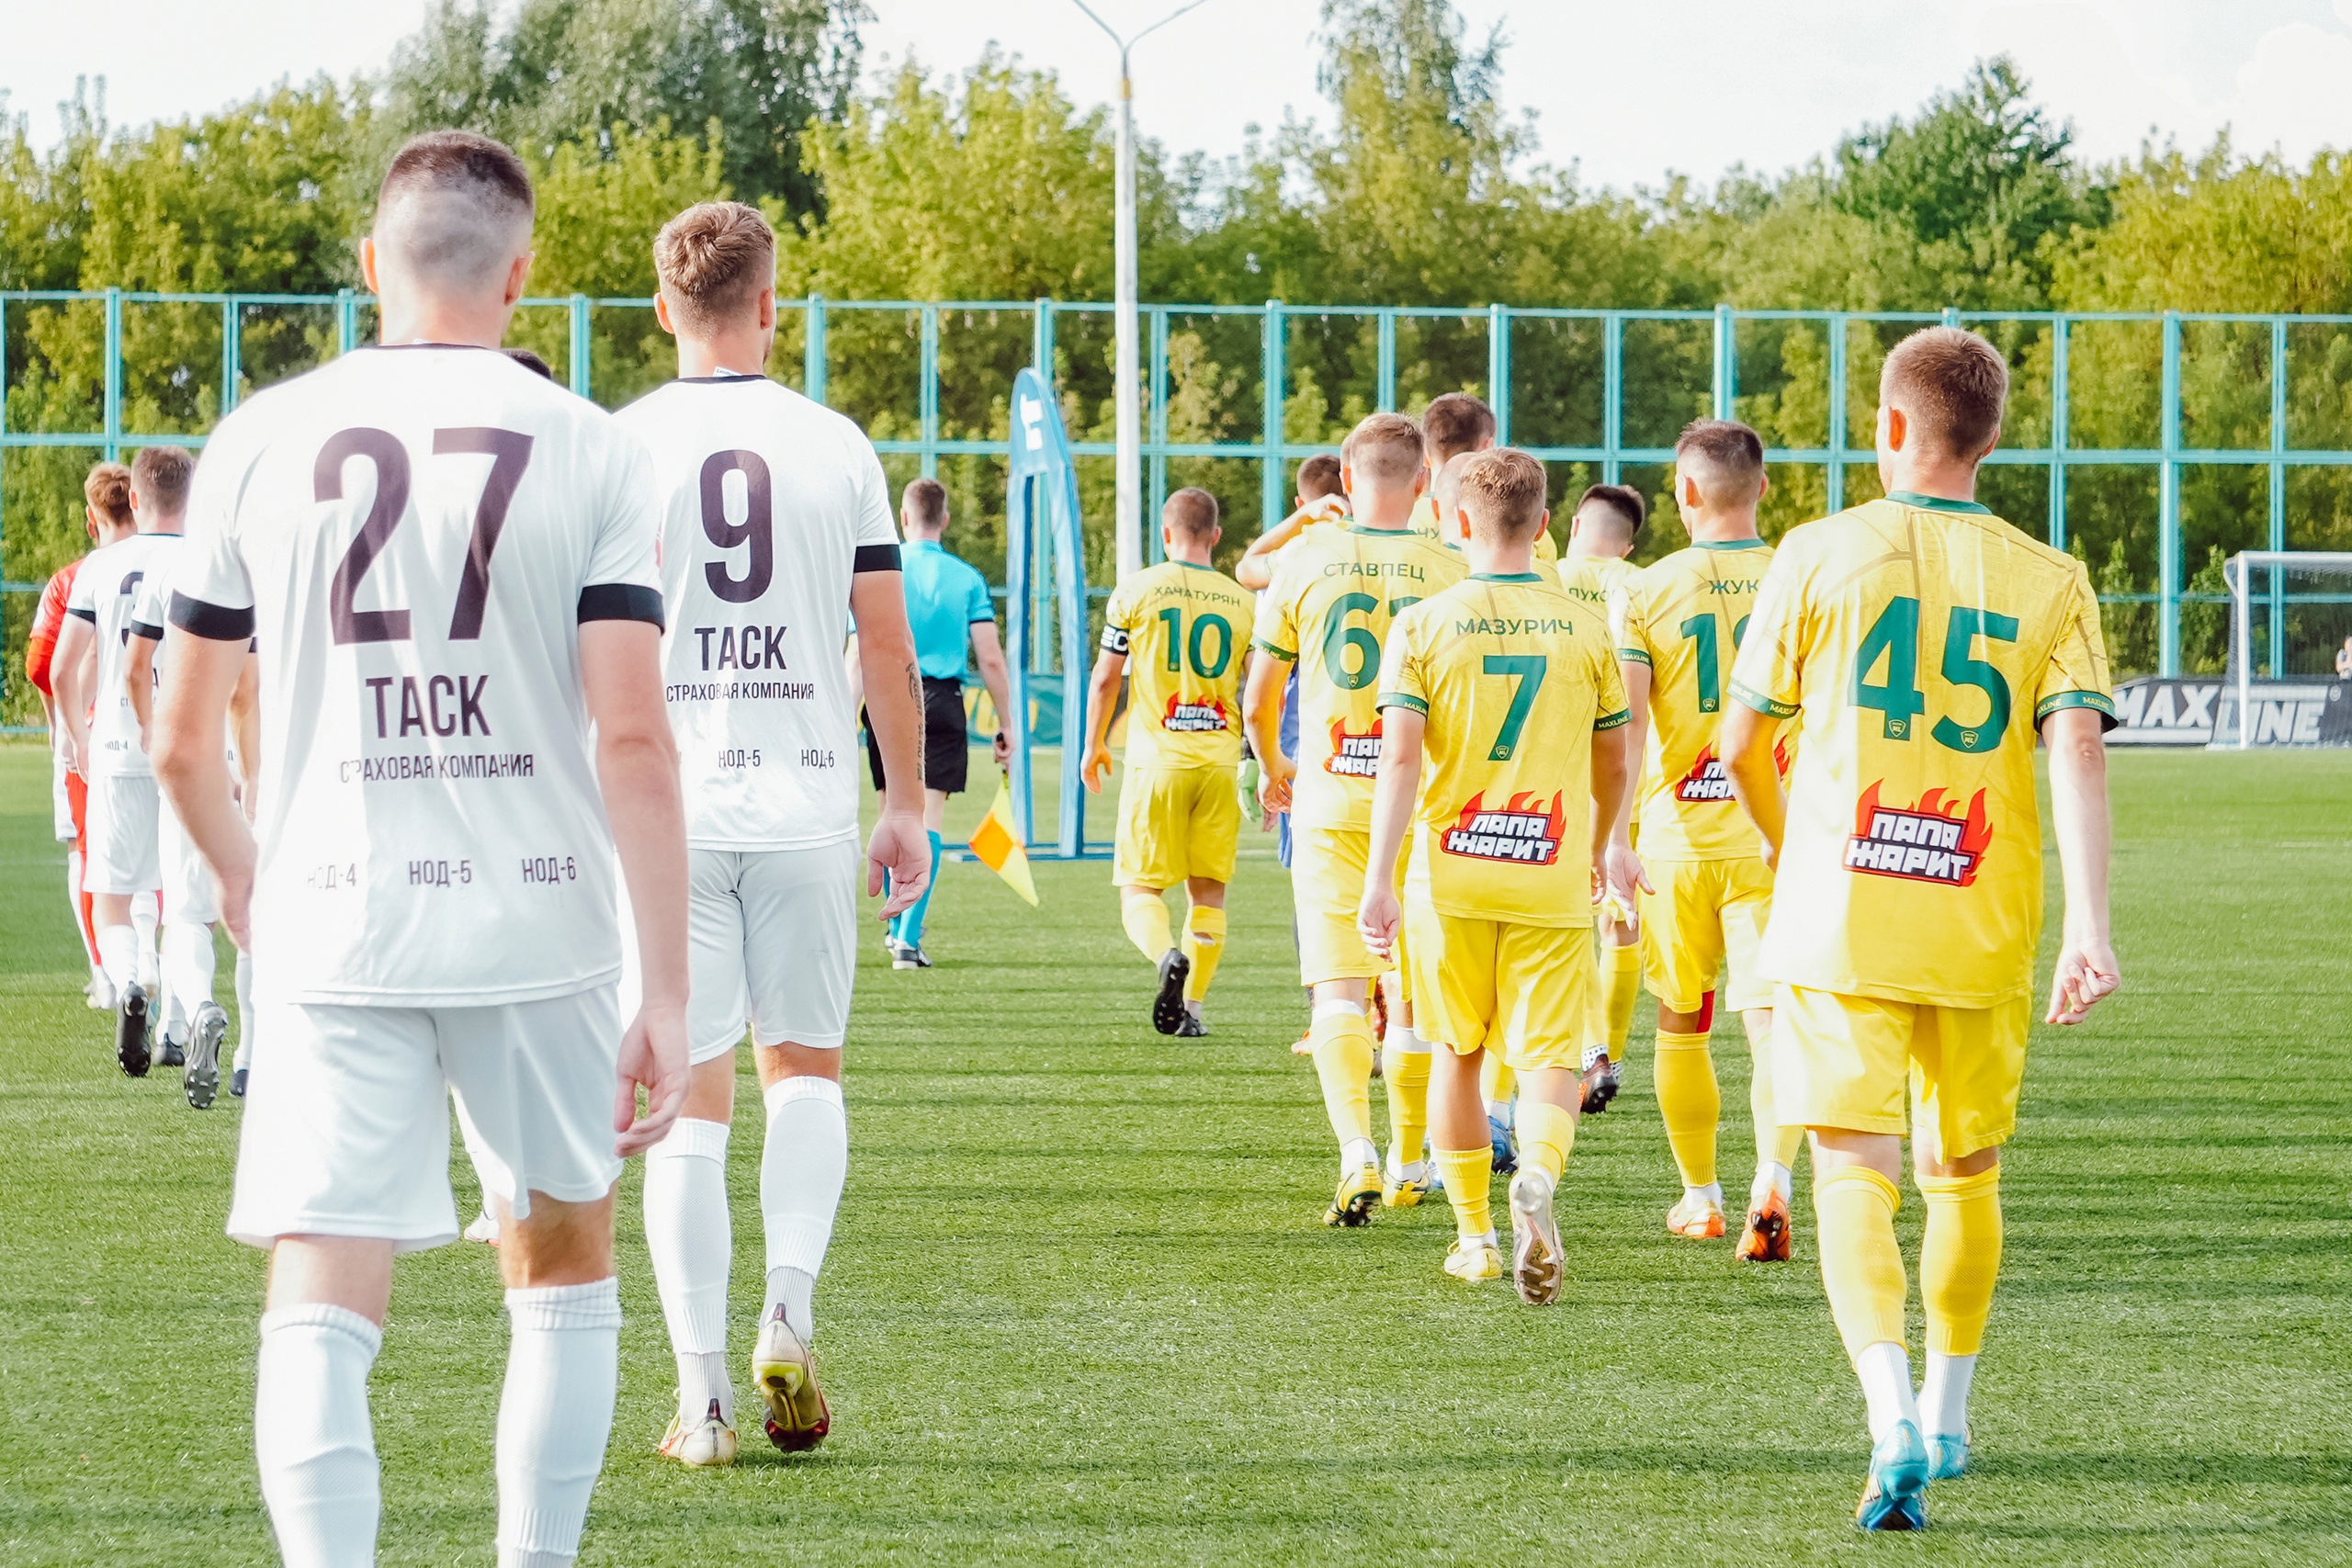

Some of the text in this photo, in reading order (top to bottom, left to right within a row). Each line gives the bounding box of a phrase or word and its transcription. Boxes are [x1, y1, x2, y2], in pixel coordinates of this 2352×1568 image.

[313, 426, 535, 647] 27
[699, 449, 773, 604] 9
[1417, 527, 1440, 540] ЧУ
[1324, 562, 1425, 583] СТАВПЕЦ
[1154, 586, 1240, 607] ХАЧАТУРЯН
[1568, 587, 1616, 603] ПУХО
[1708, 579, 1759, 594] ЖУК
[1455, 618, 1574, 636] МАЗУРИЧ
[694, 626, 787, 671] ТАСК
[1159, 607, 1232, 679] 10
[1323, 592, 1425, 690] 6
[1847, 596, 2019, 753] 45
[666, 682, 814, 702] СТРАХОВАЯ КОМПАНИЯ
[2082, 696, 2109, 711] MAXLINE
[365, 675, 492, 739] ТАСК
[1483, 655, 1547, 761] 7
[1598, 715, 1629, 728] MAXLINE
[718, 749, 762, 769] НОД-5
[801, 749, 835, 770] НОД-6
[1341, 738, 1383, 757] ПАП
[438, 753, 535, 780] КОМПАНИЯ
[1330, 756, 1378, 776] ЖАР
[1468, 814, 1547, 839] ПАПА
[1869, 812, 1962, 851] ПАПА
[1447, 830, 1555, 862] ЖАРИТ
[409, 860, 472, 887] НОД-5
[521, 856, 577, 885] НОД-6
[1844, 839, 1972, 881] ЖАРИТ
